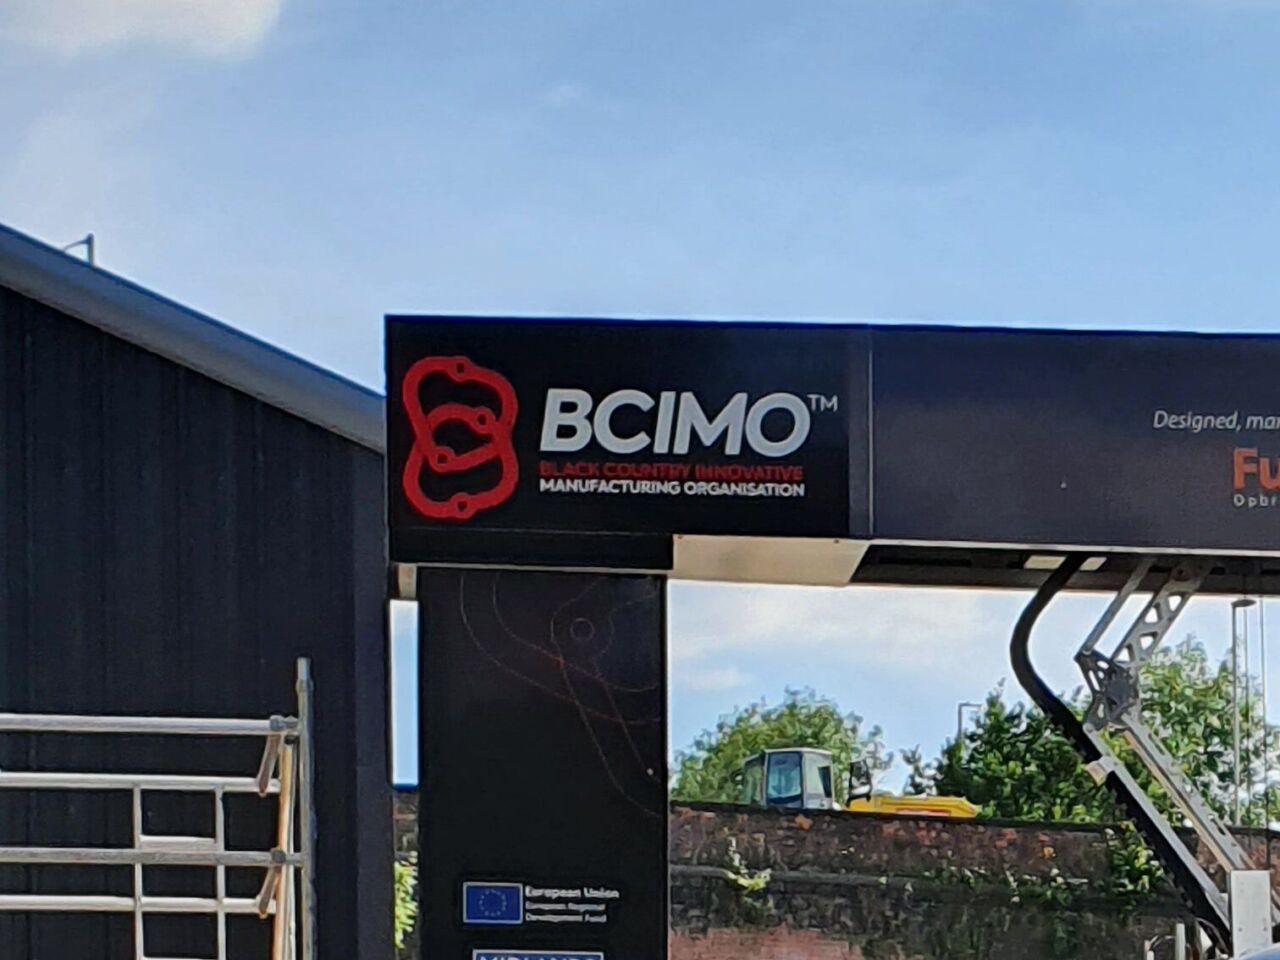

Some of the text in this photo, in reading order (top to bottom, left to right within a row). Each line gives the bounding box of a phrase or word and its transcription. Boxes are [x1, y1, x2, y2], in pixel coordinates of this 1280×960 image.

[540, 387, 811, 458] BCIMO
[1153, 410, 1242, 434] Designed,
[540, 462, 804, 481] BLACK COUNTRY INNOVATIVE
[540, 478, 805, 497] MANUFACTURING ORGANISATION
